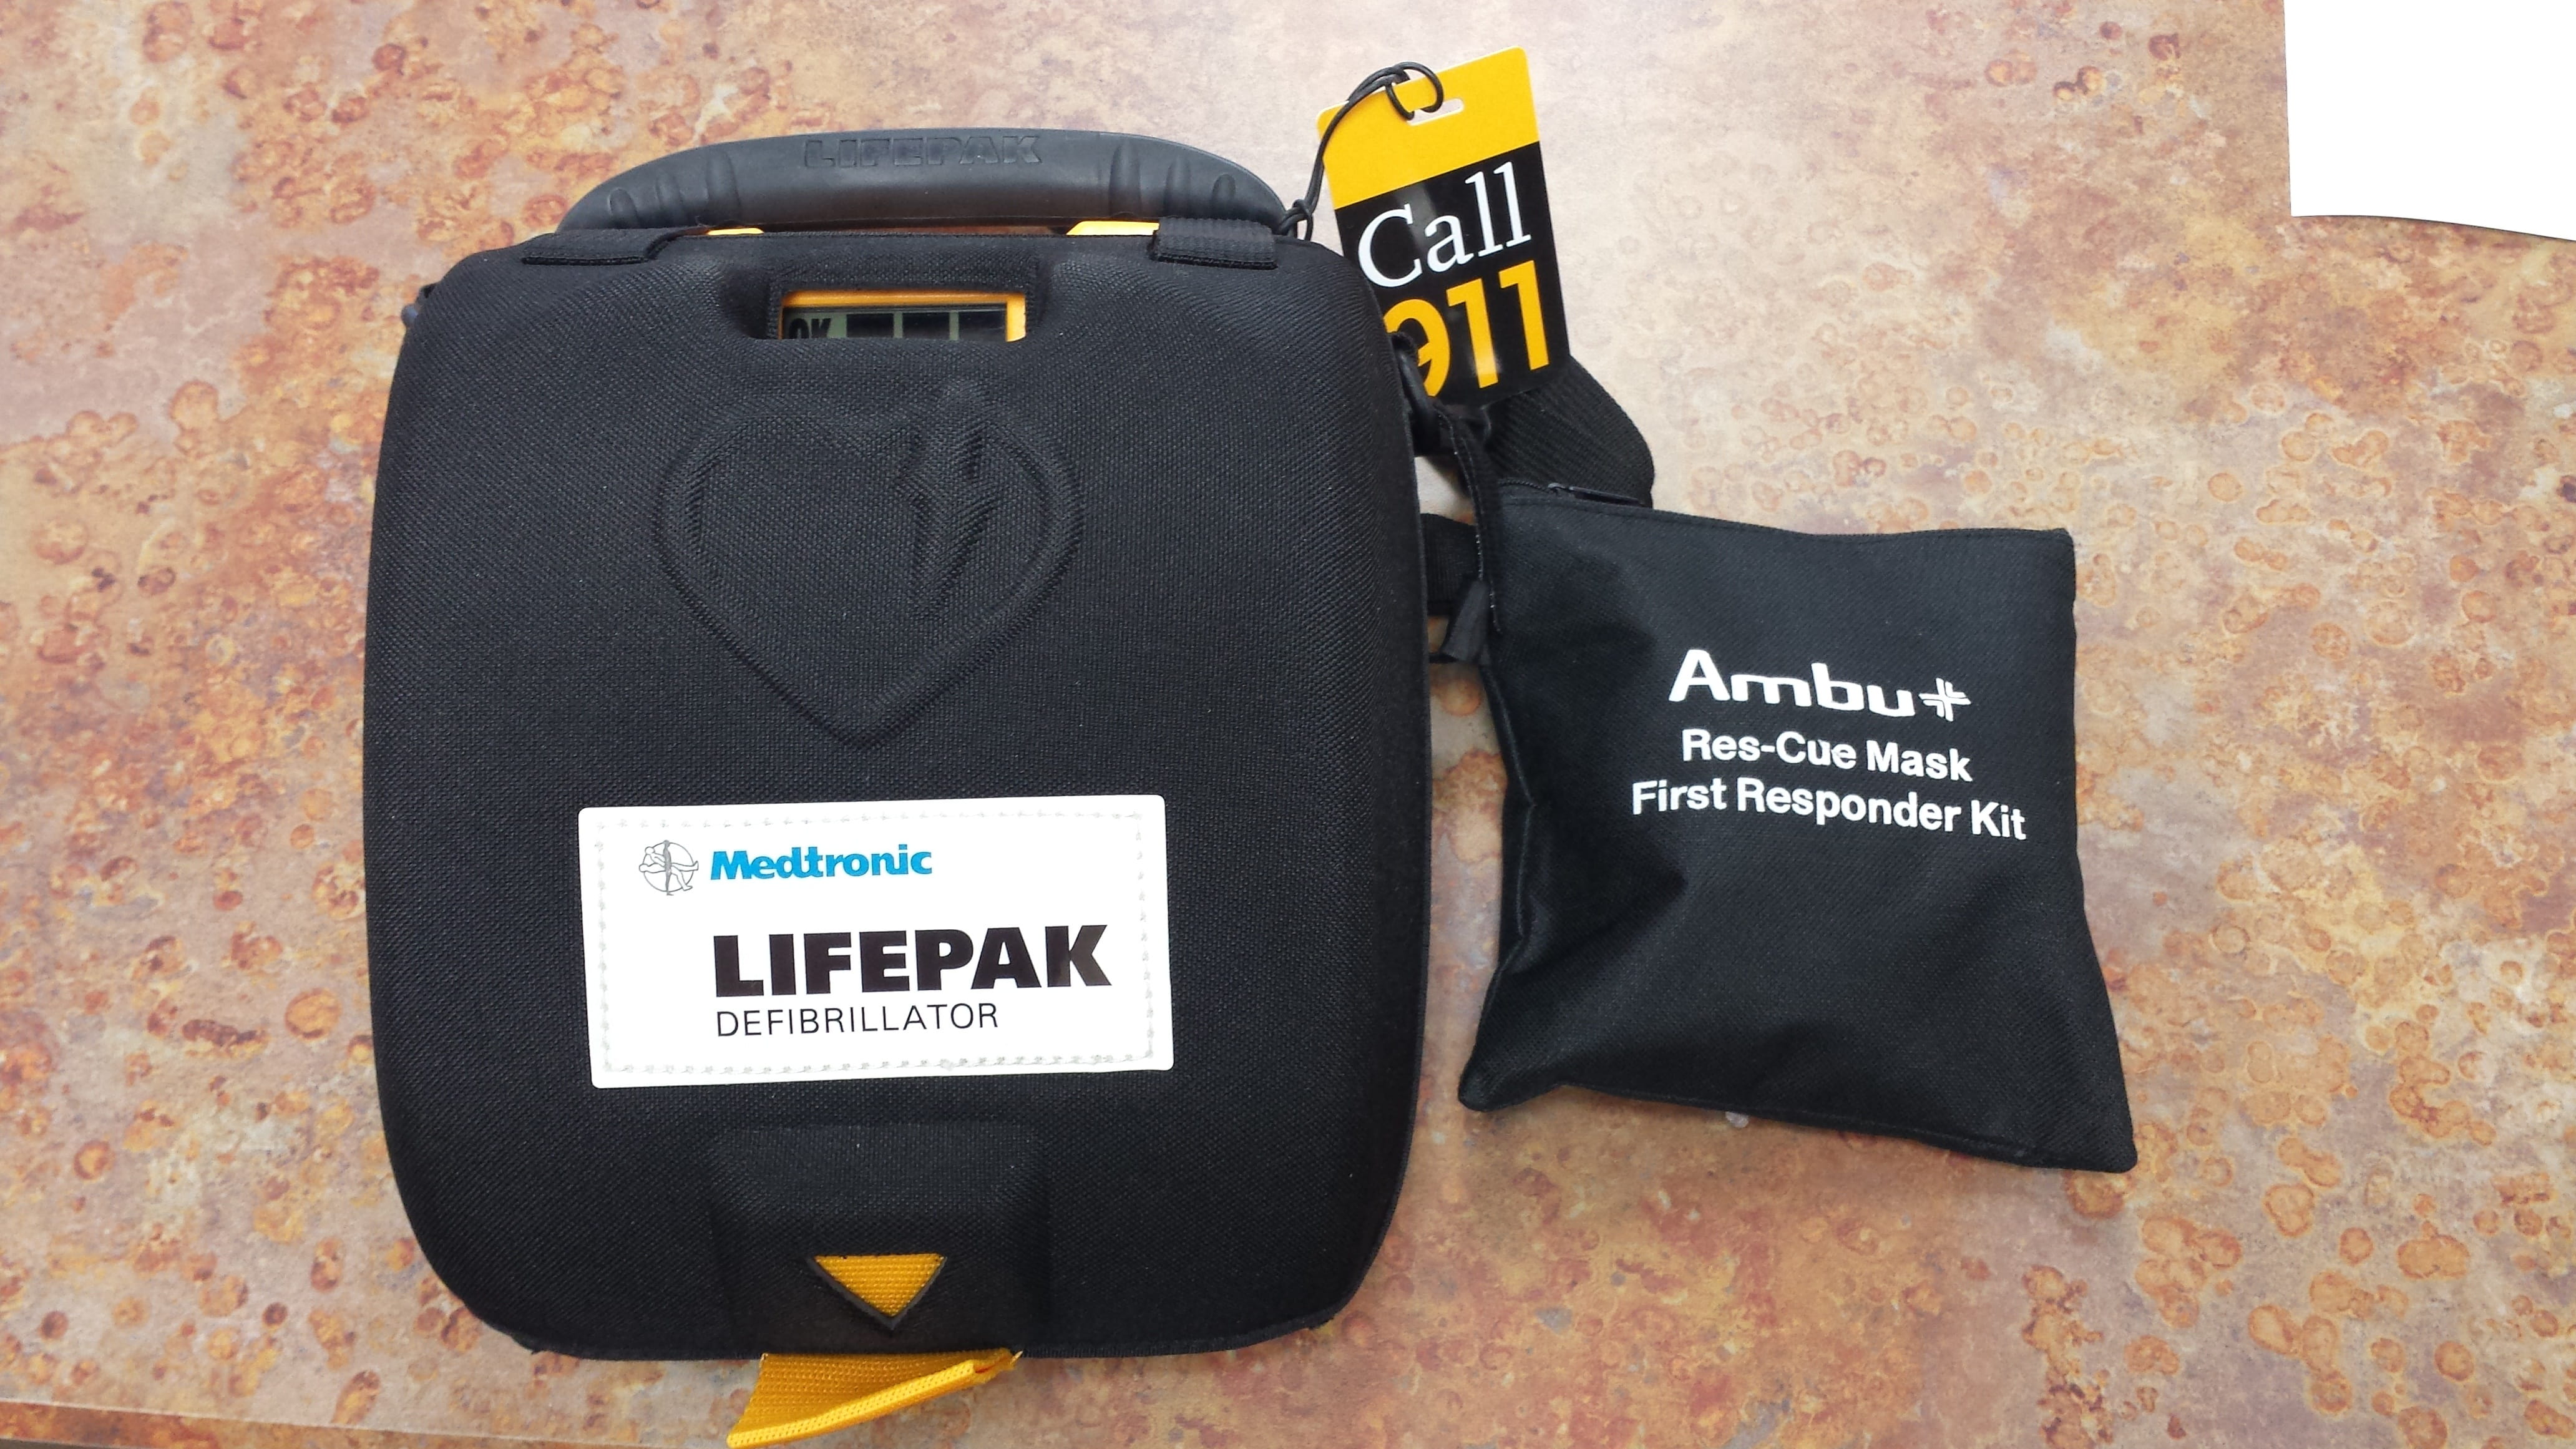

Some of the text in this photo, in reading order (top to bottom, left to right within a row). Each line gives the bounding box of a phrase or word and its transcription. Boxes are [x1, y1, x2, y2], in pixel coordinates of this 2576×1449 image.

[804, 136, 1043, 167] LIFEPAK
[1358, 161, 1531, 287] Call
[1383, 260, 1549, 397] 911
[1669, 649, 1915, 717] Ambu
[1682, 728, 1973, 783] Res-Cue Mask
[1632, 777, 2027, 841] First Responder Kit
[710, 844, 932, 881] Medtronic
[713, 925, 1112, 998] LIFEPAK
[716, 1003, 998, 1037] DEFIBRILLATOR
